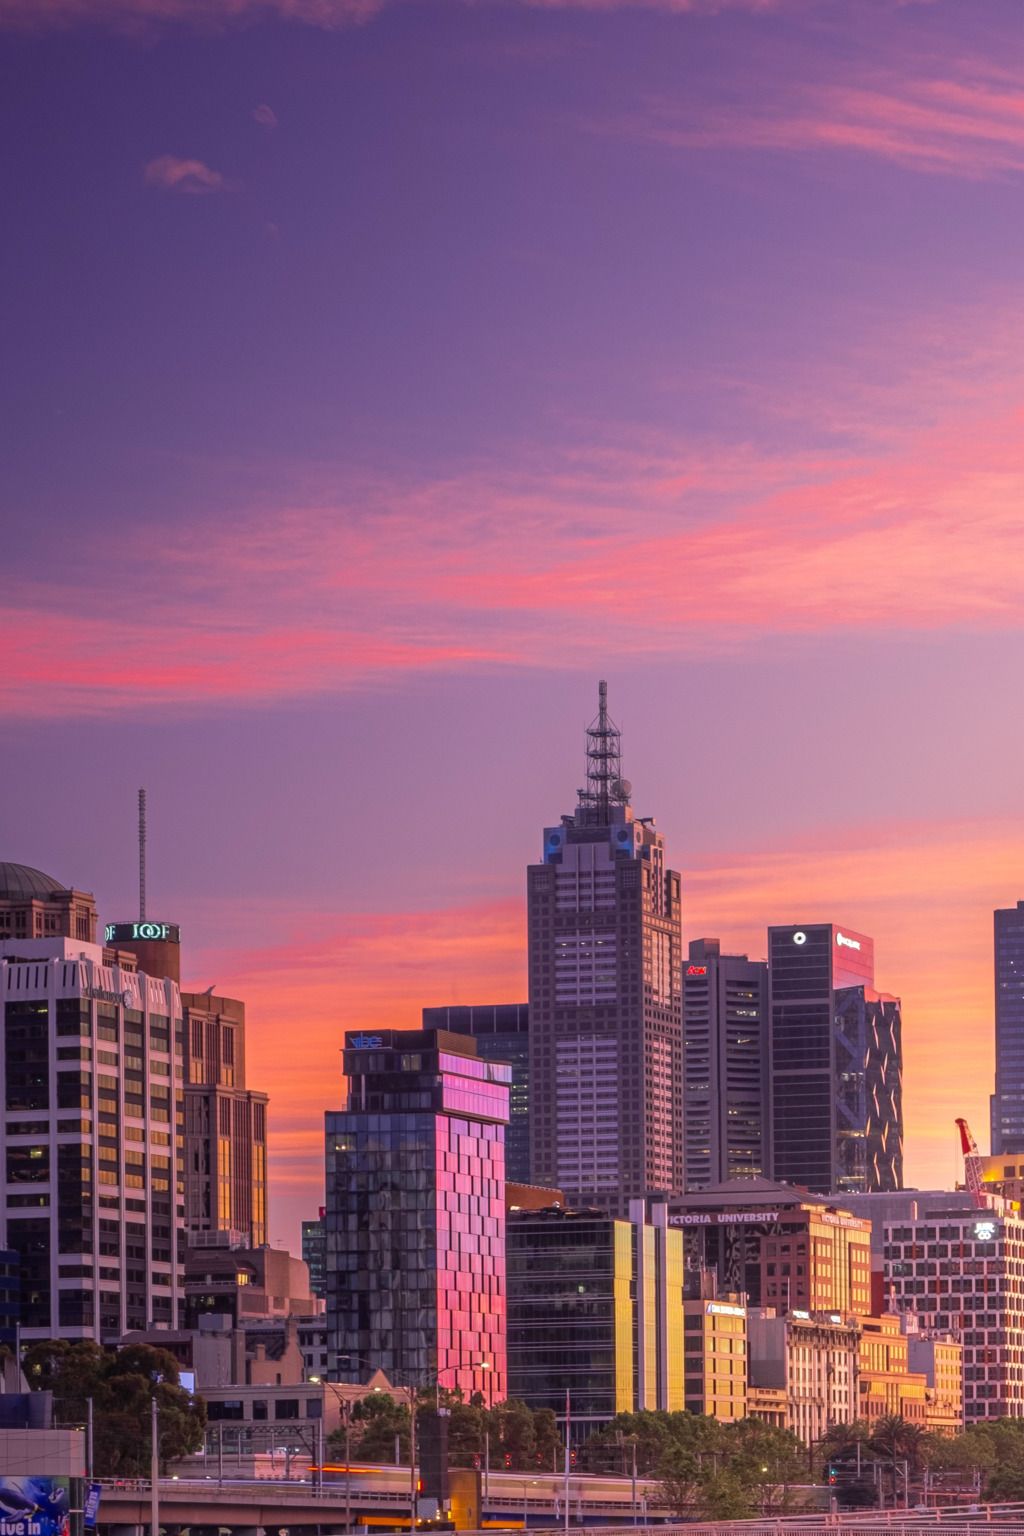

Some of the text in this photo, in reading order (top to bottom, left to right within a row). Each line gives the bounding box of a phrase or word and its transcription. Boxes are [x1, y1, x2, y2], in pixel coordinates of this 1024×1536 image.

[132, 923, 170, 939] IOOF
[350, 1032, 383, 1049] vibe
[667, 1212, 779, 1225] ICTORIA UNIVERSITY
[27, 1518, 41, 1536] in
